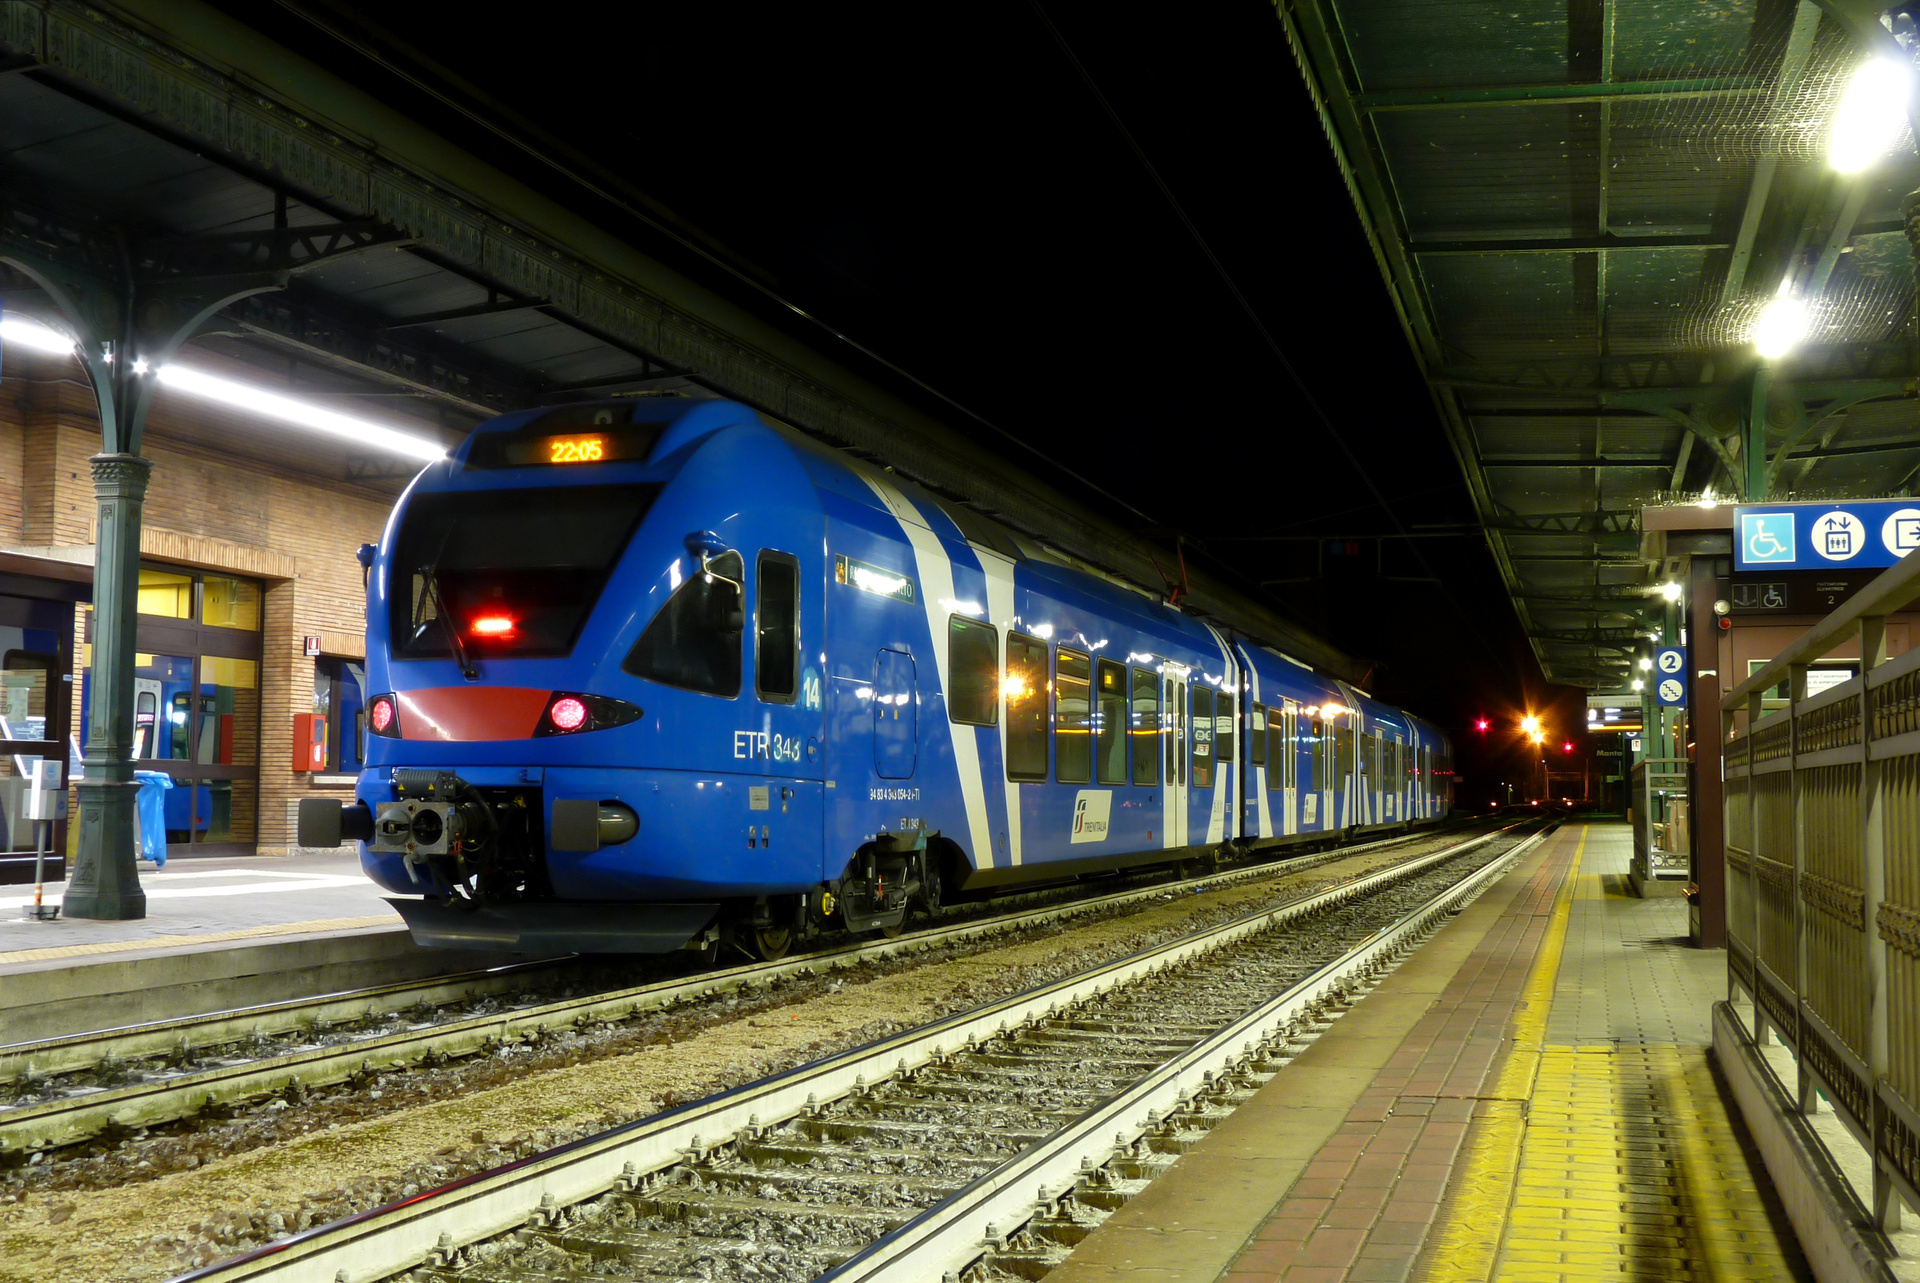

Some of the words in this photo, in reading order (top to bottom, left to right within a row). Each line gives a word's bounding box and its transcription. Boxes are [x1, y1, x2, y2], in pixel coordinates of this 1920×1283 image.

[550, 440, 602, 462] 22:05
[1827, 595, 1835, 605] 2
[1664, 655, 1676, 669] 2
[803, 677, 820, 708] 14
[734, 730, 769, 760] ETR
[773, 733, 800, 761] 343
[1084, 821, 1107, 833] TRENITALIA
